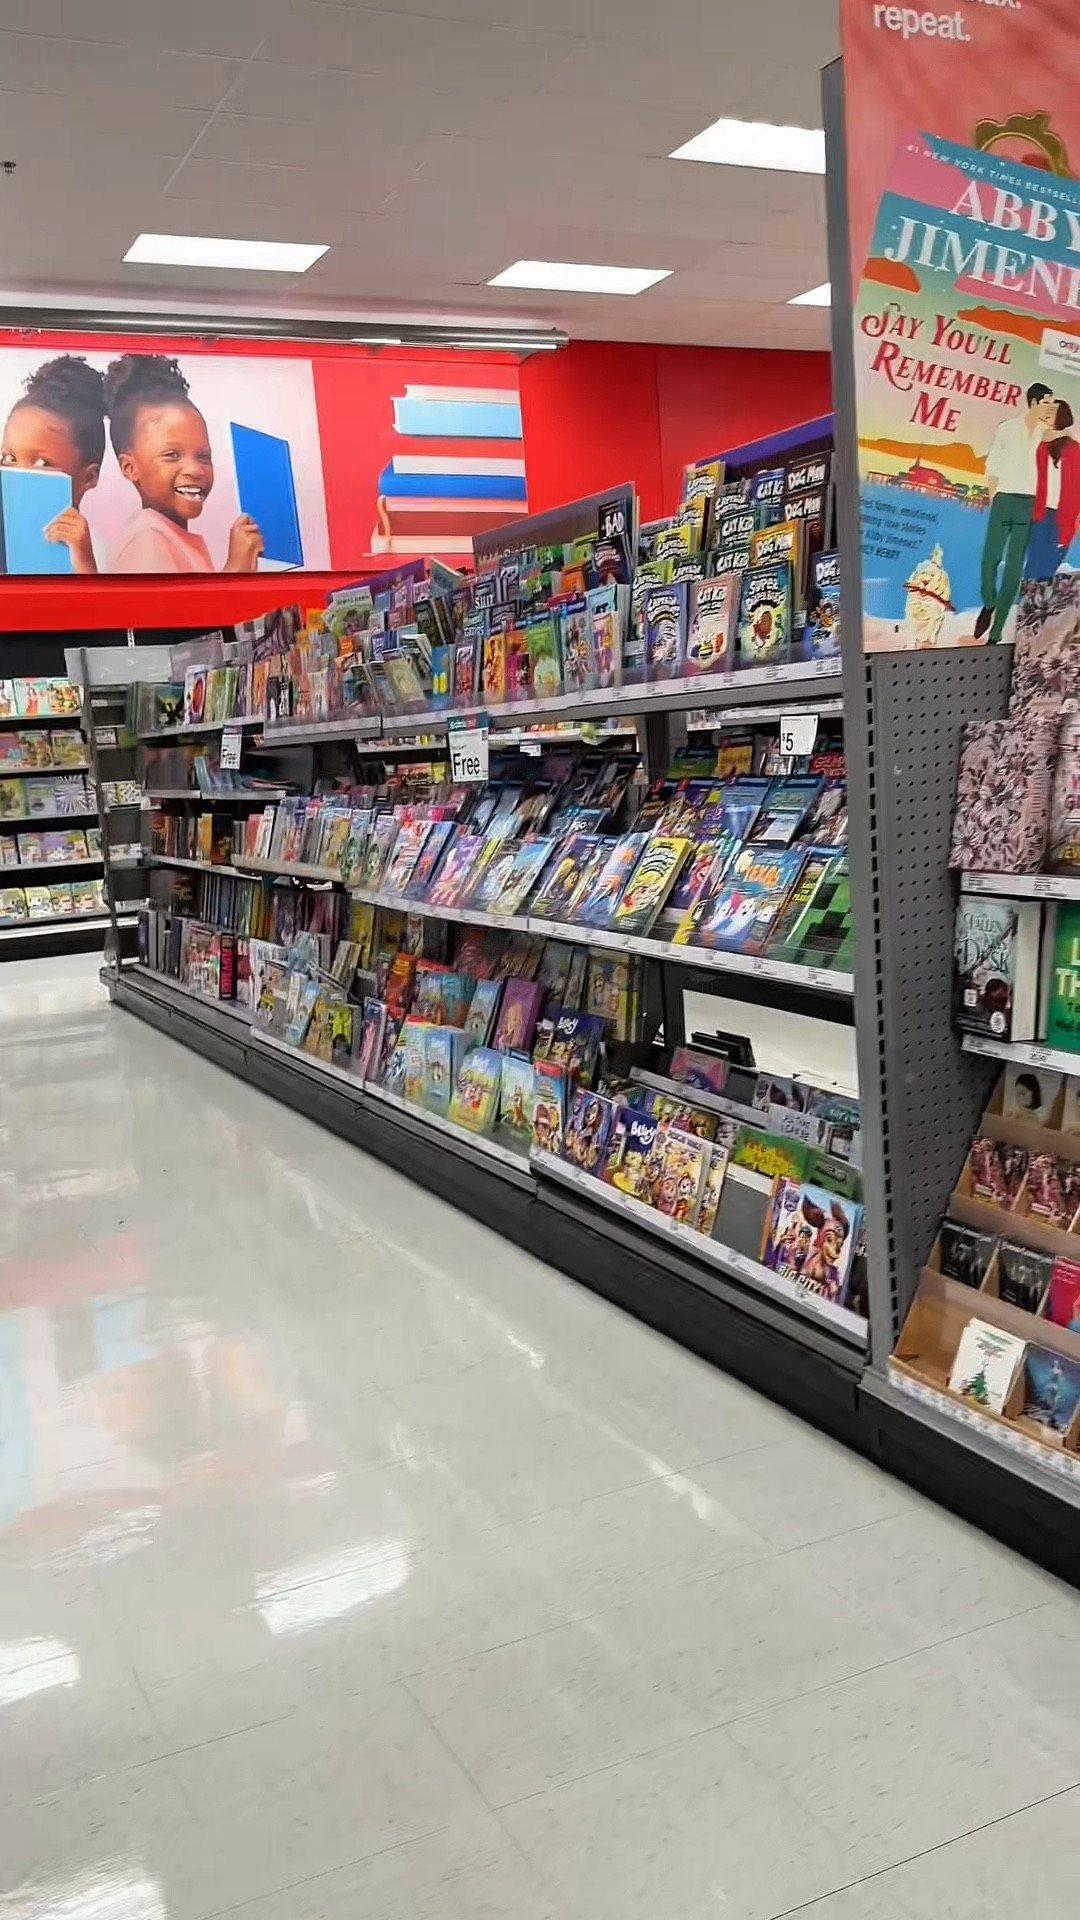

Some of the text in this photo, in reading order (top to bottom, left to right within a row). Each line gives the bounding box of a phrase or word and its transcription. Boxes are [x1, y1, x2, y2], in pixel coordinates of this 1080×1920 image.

[874, 4, 971, 41] repeat.
[923, 150, 951, 164] NEW
[954, 159, 985, 175] YORK
[988, 170, 1022, 187] TIMES
[1024, 181, 1080, 204] BESTSELL
[870, 340, 1022, 407] REMEMBER
[909, 391, 961, 432] ME
[782, 732, 794, 751] $5
[453, 753, 480, 777] Free
